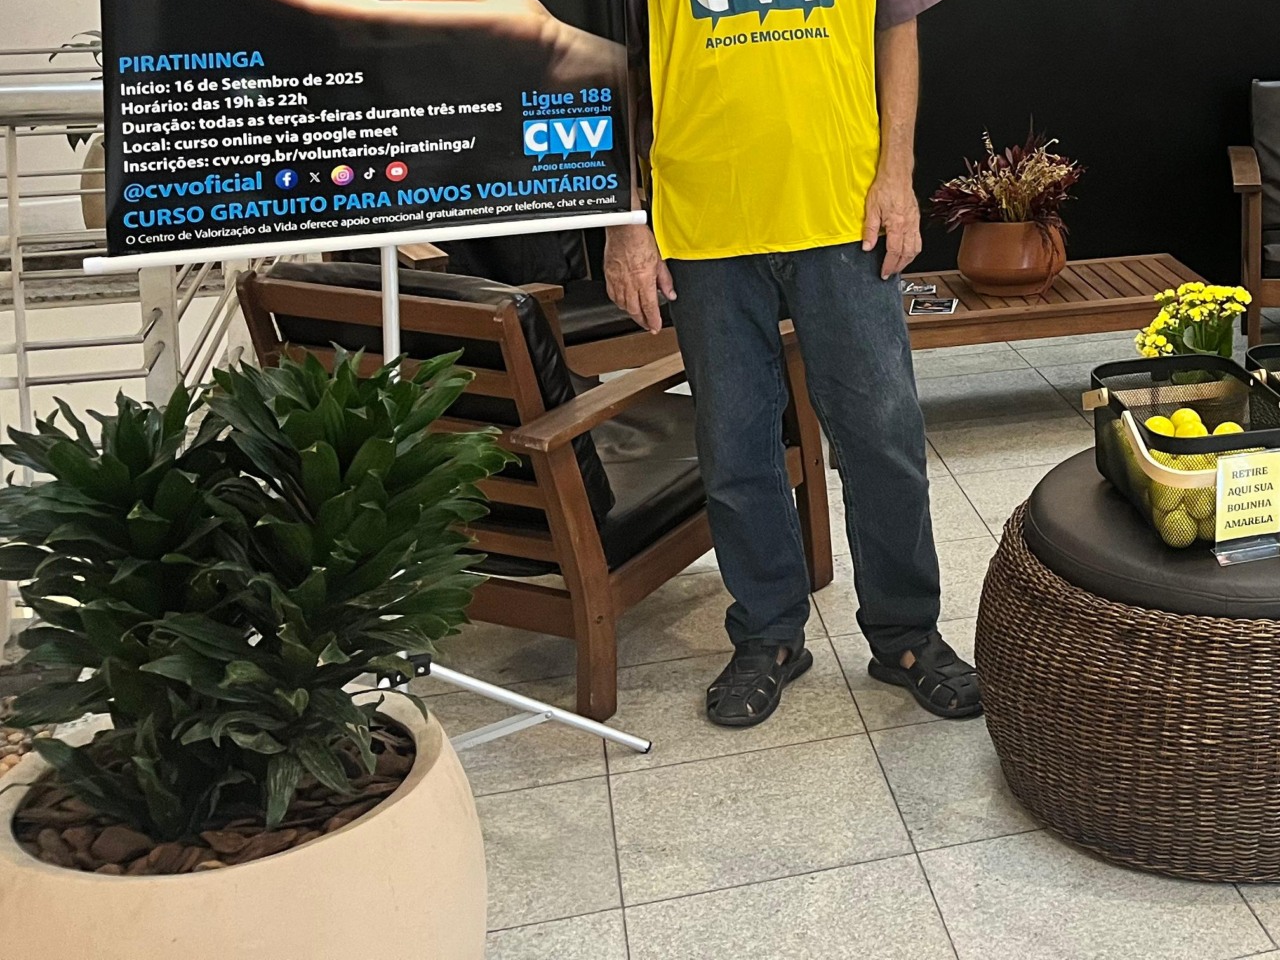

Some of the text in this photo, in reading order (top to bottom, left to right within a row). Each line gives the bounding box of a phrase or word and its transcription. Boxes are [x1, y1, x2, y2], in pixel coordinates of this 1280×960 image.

[705, 27, 829, 49] APOIO EMOCIONAL
[119, 51, 264, 73] PIRATININGA
[121, 72, 363, 96] Início: 16 de Setembro de 2025
[121, 93, 307, 115] Horário: das 19h às 22h
[522, 88, 611, 109] Ligue 188
[535, 107, 565, 115] acesse
[567, 104, 611, 115] cvv.org.br
[122, 102, 502, 134] Duração: todas as terças-feiras durante três meses
[123, 126, 398, 154] Local: curso online via google meet
[525, 119, 608, 152] CVV
[124, 137, 476, 173] Inscrições: cvv.org.br/voluntarios/piratininga/
[532, 160, 606, 172] APOIO EMOCIONAL
[124, 171, 262, 202] @cvvoficial
[124, 174, 618, 228] CURSO GRATUITO PARA NOVOS VOLUNTÁRIOS
[126, 236, 135, 245] O
[138, 233, 175, 244] Centro
[178, 231, 192, 241] de
[195, 226, 255, 239] Valorização
[258, 224, 272, 234] da
[274, 222, 297, 232] Vida
[300, 219, 338, 230] oferece
[341, 216, 370, 227] apoio
[372, 211, 423, 224] emocional
[426, 205, 494, 220] gratuitamente
[496, 204, 512, 215] por
[515, 200, 554, 211] telefone,
[557, 198, 576, 207] chat
[587, 195, 617, 205] e-mail.
[1232, 467, 1268, 479] RETIRE
[1228, 482, 1274, 496] AQUI SUA
[1227, 499, 1272, 512] BOLINHA
[1224, 515, 1273, 529] AMARELA
